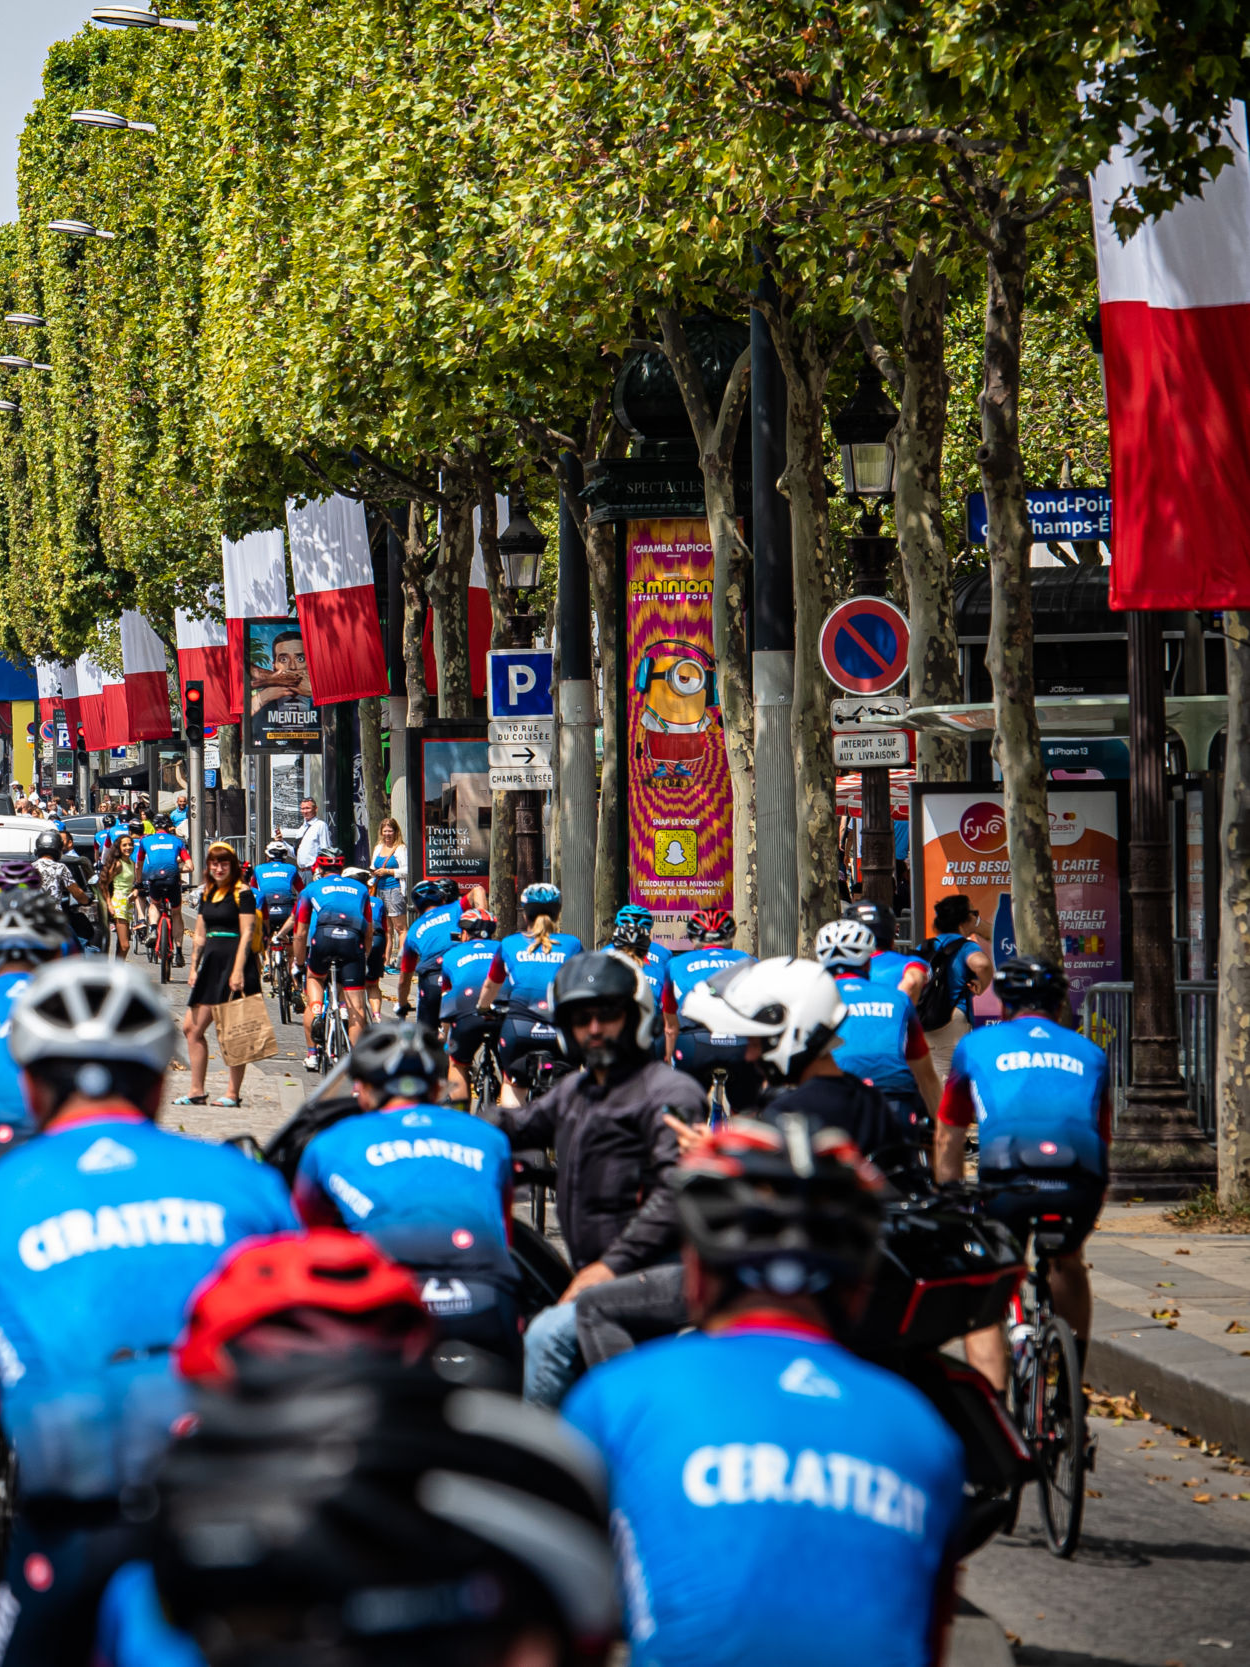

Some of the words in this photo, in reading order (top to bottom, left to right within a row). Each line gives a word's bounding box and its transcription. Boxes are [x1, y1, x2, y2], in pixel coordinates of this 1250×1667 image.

[626, 479, 705, 494] SPECTACLES
[508, 664, 537, 706] P
[267, 710, 318, 724] MENTEUR
[521, 724, 540, 732] RUE
[512, 732, 550, 741] COLISÉE
[841, 738, 873, 749] INTERDIT
[877, 737, 898, 748] SAUF
[839, 752, 855, 762] AUX
[858, 750, 901, 761] LIVRAISONS
[1054, 747, 1079, 756] iPhone
[1079, 747, 1089, 756] 13
[652, 818, 671, 826] SNAP
[671, 818, 679, 826] LE
[680, 818, 701, 826] CODE
[426, 825, 469, 835] Trouvez
[429, 846, 465, 857] parfait
[429, 858, 454, 869] pour
[455, 858, 481, 867] vous
[945, 860, 976, 874] PLUS
[979, 860, 1012, 873] BESO
[1062, 859, 1100, 871] CARTE
[676, 880, 688, 888] LES
[689, 880, 725, 888] MINIONS
[941, 876, 954, 886] OU
[956, 876, 968, 886] DE
[969, 875, 989, 885] SON
[1069, 874, 1099, 884] PAYER
[678, 888, 717, 896] TRIOMPHE
[1059, 910, 1105, 921] RACELET
[1063, 920, 1107, 930] PAIEMENT
[1073, 960, 1105, 969] CONTACT
[995, 1050, 1085, 1076] CERATIZIT
[365, 1137, 486, 1172] CERATIZIT
[18, 1197, 226, 1272] CERATIZIT
[681, 1442, 928, 1538] CERATIZIT
